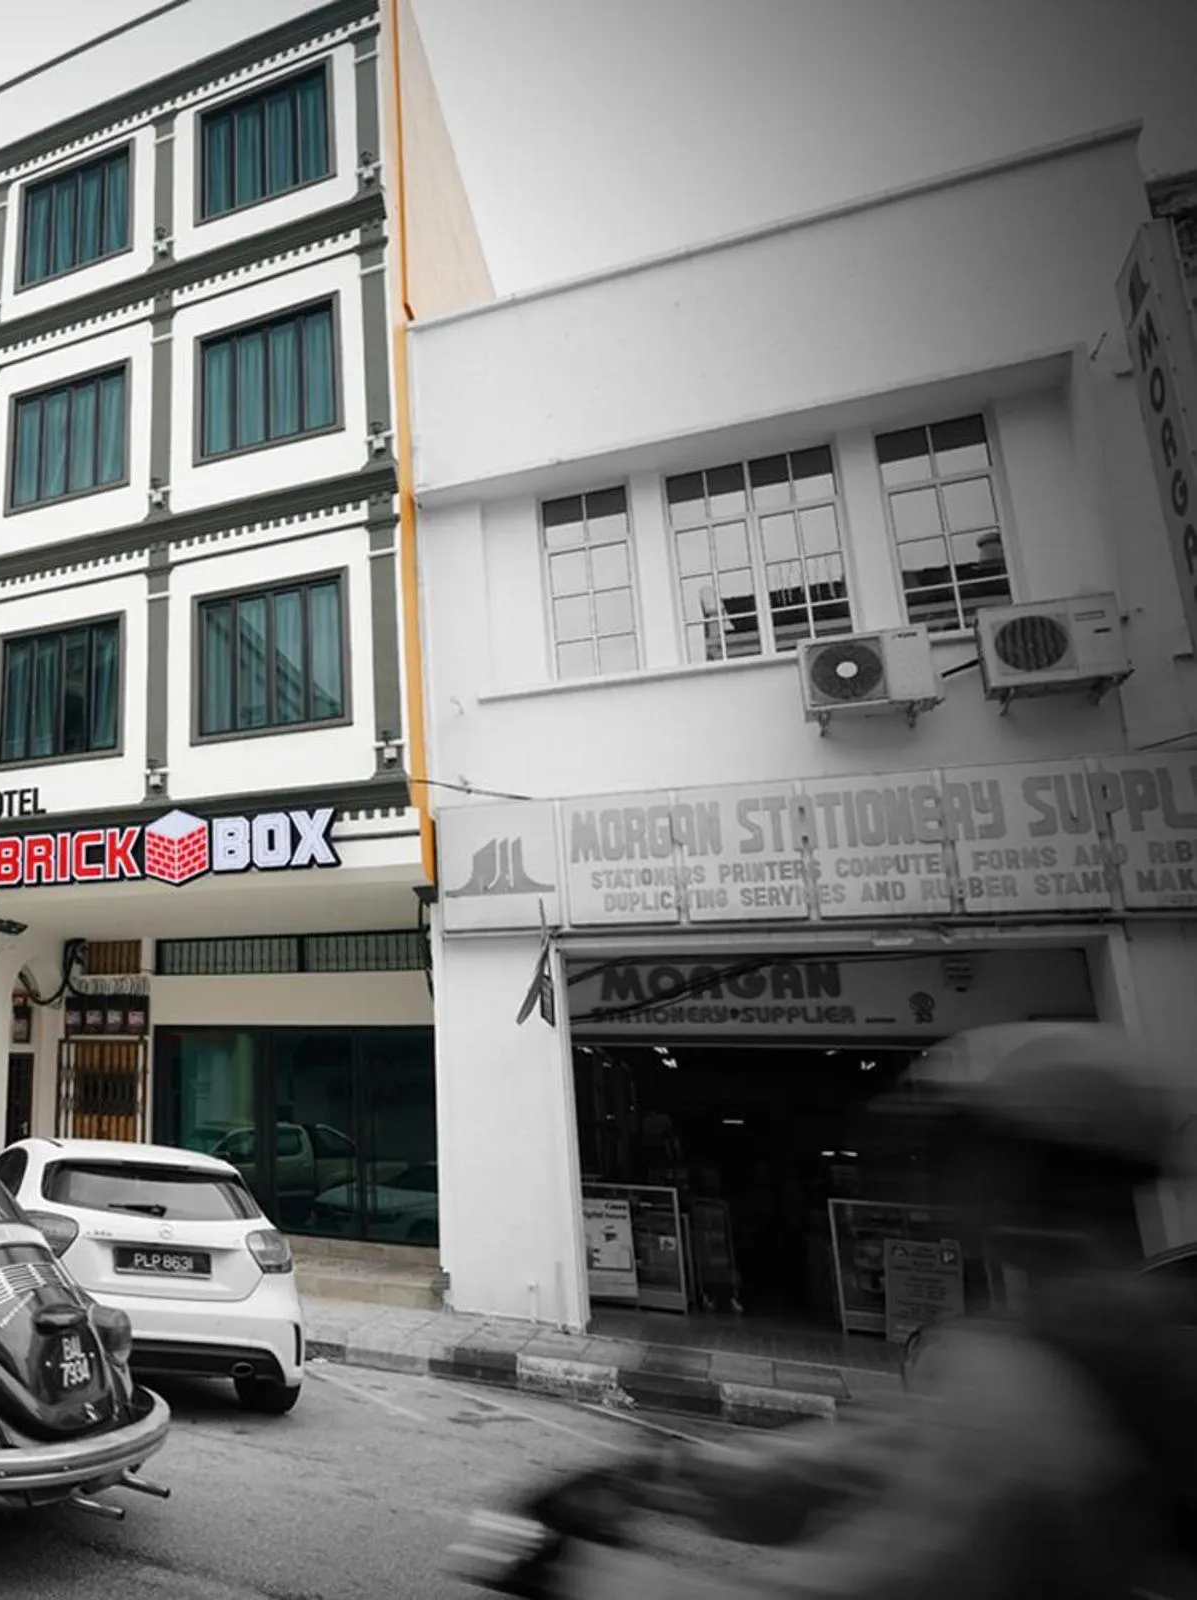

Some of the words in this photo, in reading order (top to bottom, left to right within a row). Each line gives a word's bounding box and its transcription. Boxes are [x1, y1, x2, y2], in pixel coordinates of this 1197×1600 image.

[1139, 310, 1197, 612] MORGA
[570, 801, 722, 863] MORGAN
[1021, 765, 1197, 839] SUPPL
[211, 807, 337, 872] BOX
[972, 845, 1058, 871] FORMS
[1147, 839, 1197, 865] RIB
[860, 880, 906, 902] AND
[134, 1252, 161, 1267] PLP
